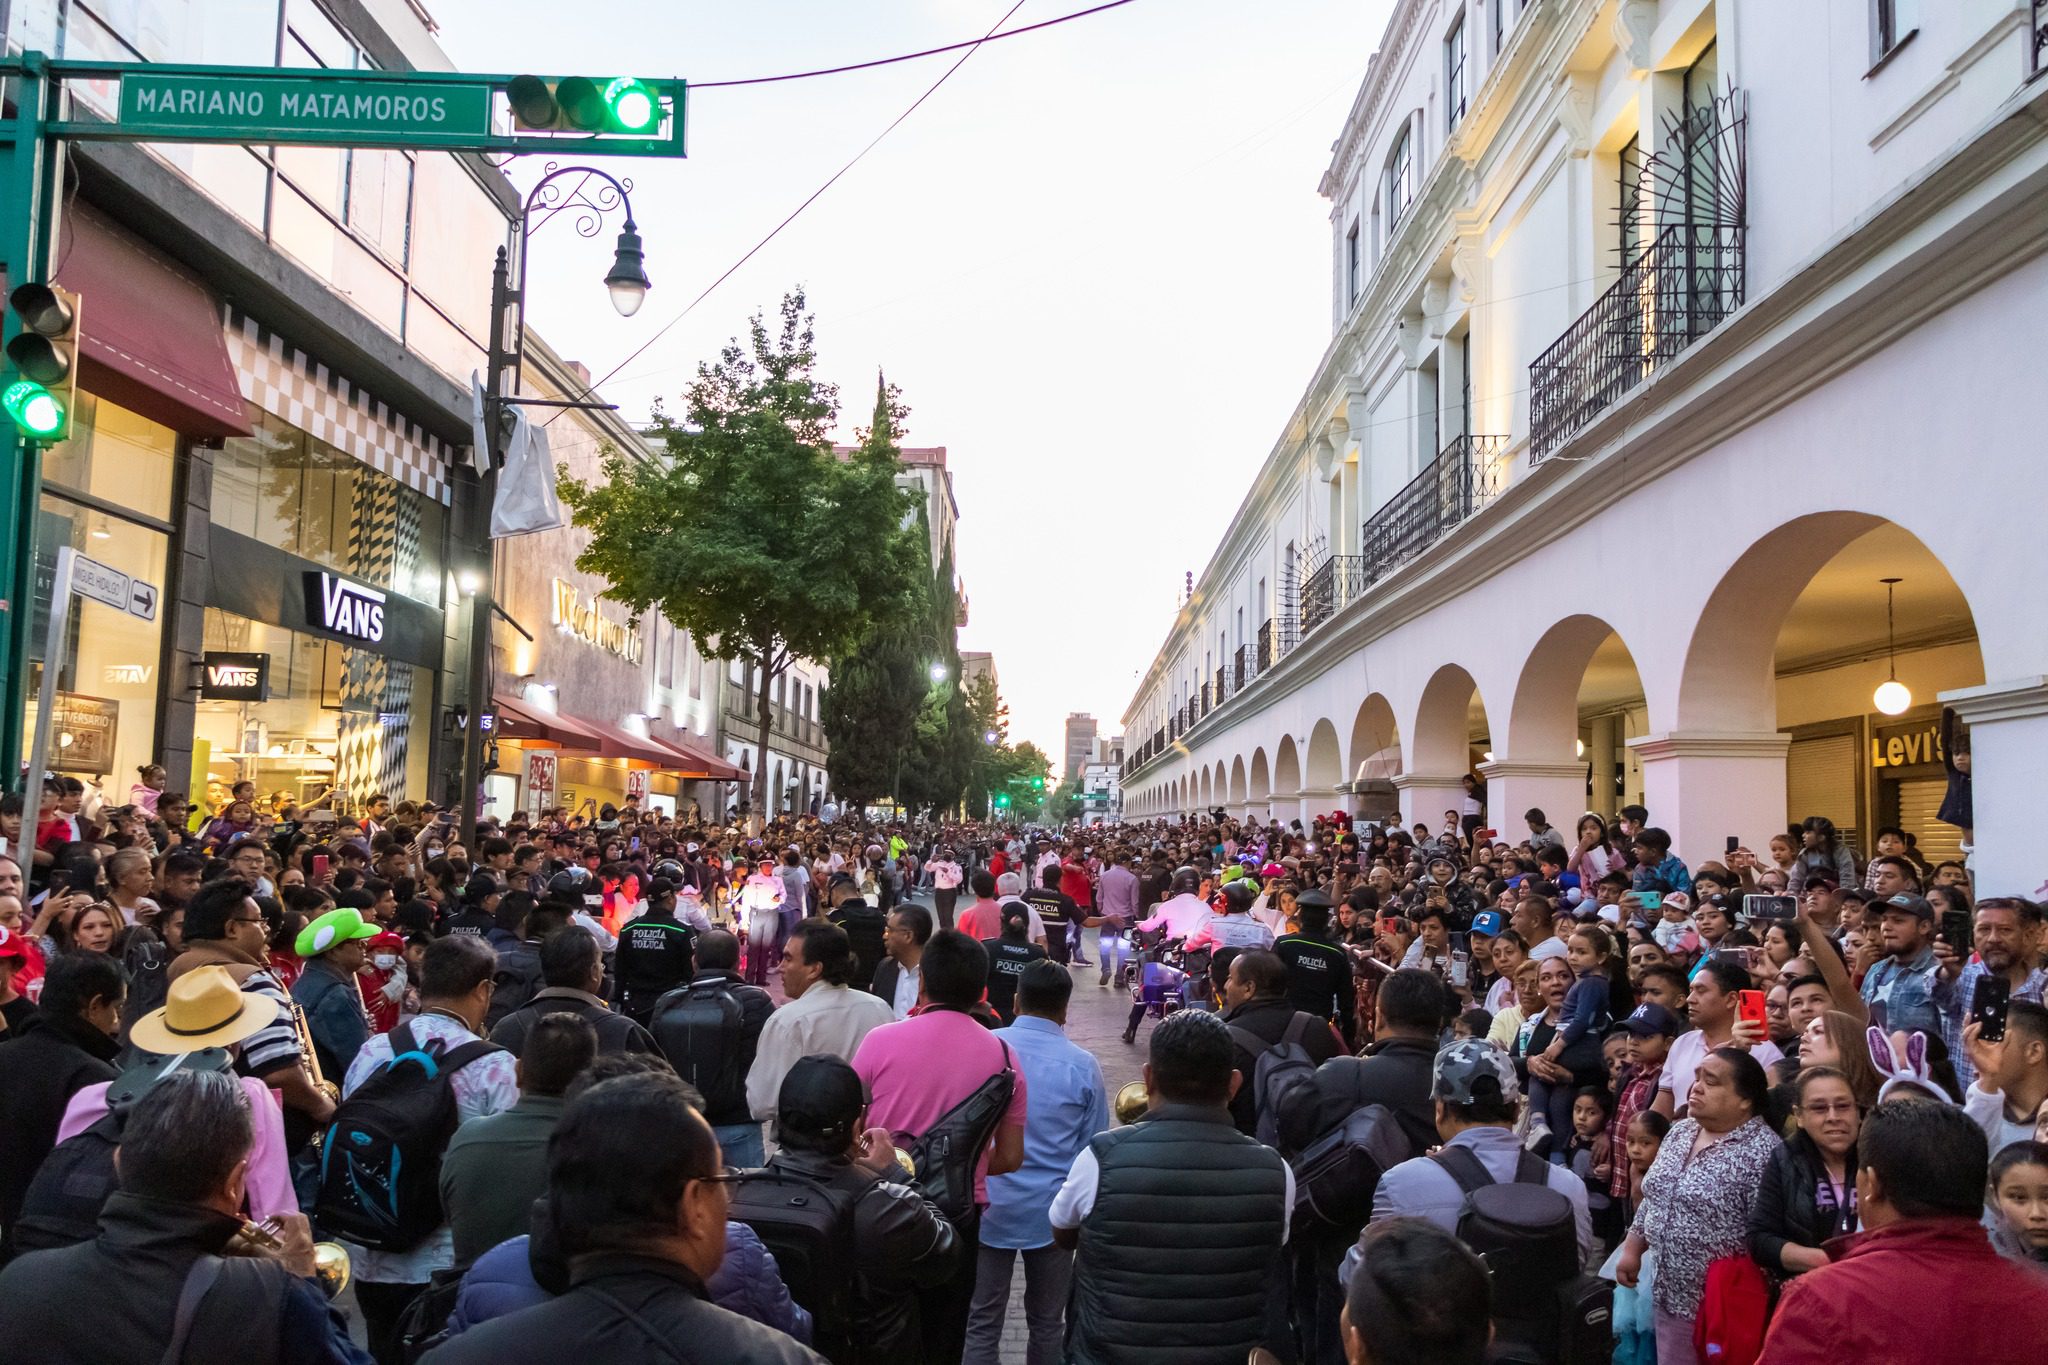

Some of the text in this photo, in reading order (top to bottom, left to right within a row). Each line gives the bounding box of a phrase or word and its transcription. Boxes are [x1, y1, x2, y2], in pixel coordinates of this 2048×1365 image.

[136, 87, 447, 122] MARIANO MATAMOROS
[321, 571, 386, 642] VANS
[207, 665, 259, 687] VANS
[52, 711, 109, 728] IVERSARIO
[457, 714, 493, 729] VS
[1029, 902, 1059, 914] POLICÍA
[450, 925, 482, 935] POLICÍA
[632, 928, 667, 940] POLICÍA
[631, 939, 665, 950] TOLUCA
[996, 961, 1026, 973] POLIC
[1297, 955, 1328, 969] POLICÍA
